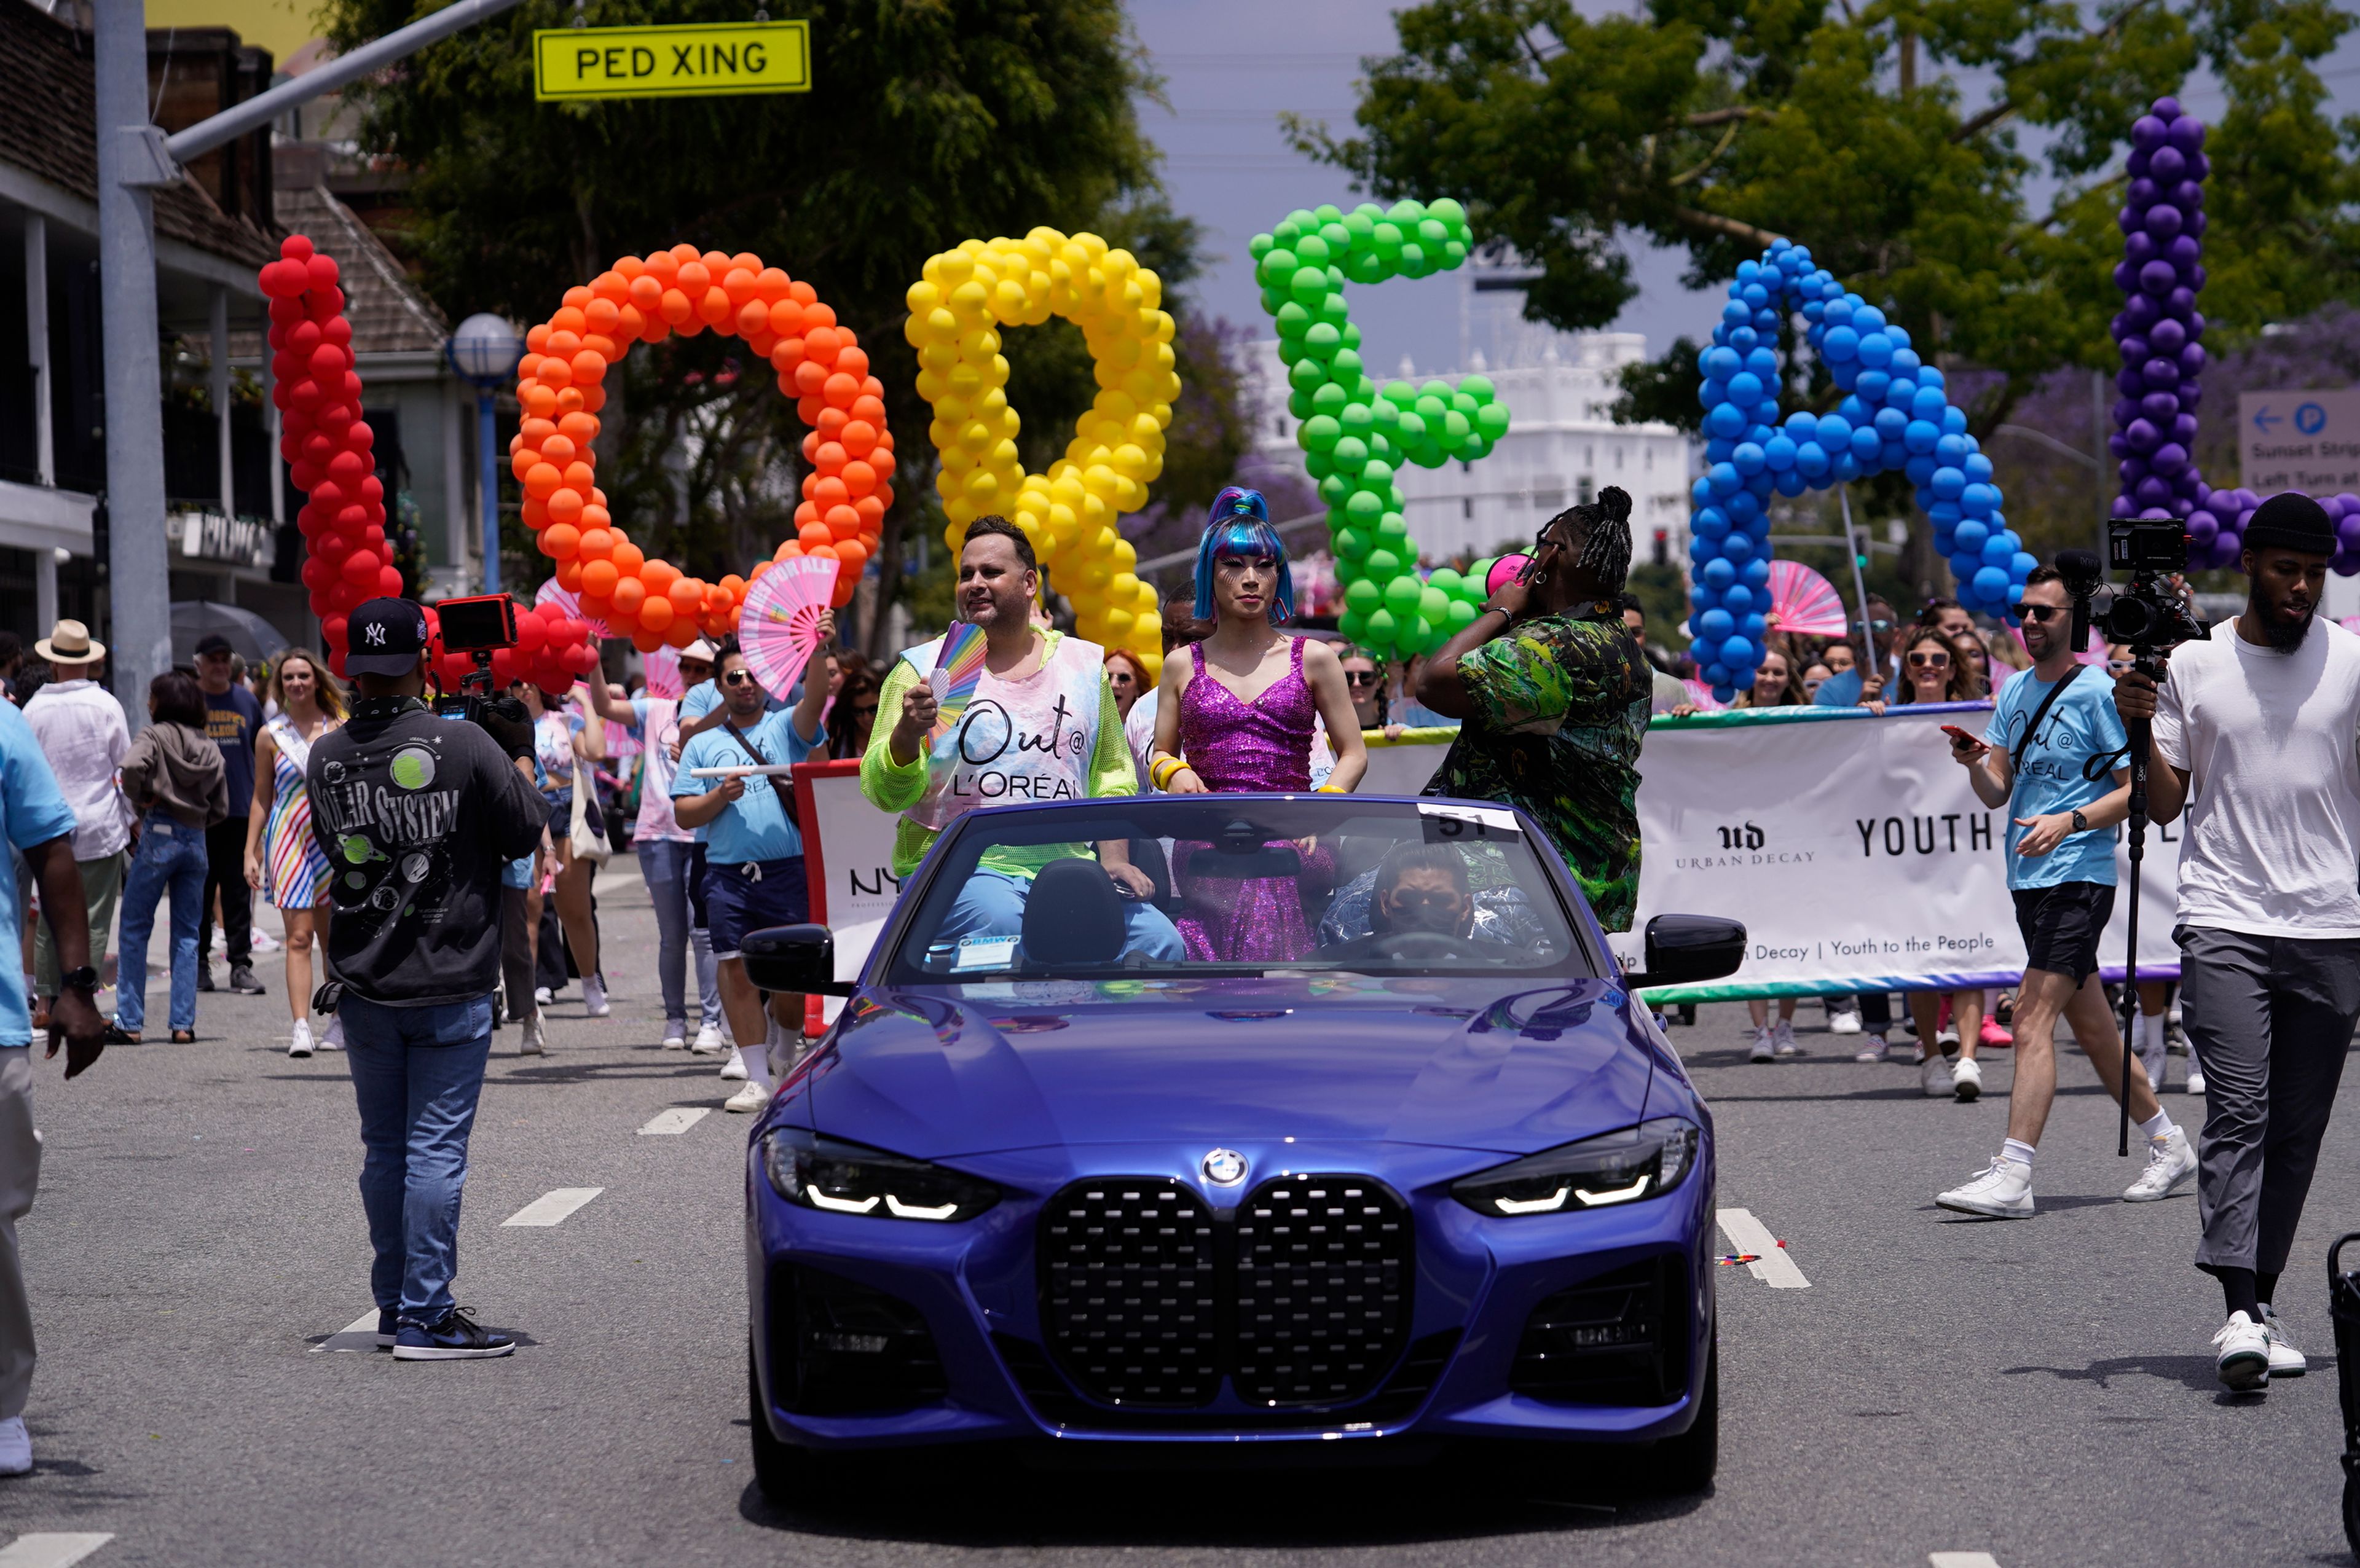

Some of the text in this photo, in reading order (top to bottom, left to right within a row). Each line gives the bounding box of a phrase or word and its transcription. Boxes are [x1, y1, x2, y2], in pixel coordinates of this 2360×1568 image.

[576, 42, 768, 79] PED XING
[2251, 442, 2313, 458] Sunset
[2251, 471, 2289, 487] Left
[2294, 470, 2336, 486] Turn
[766, 560, 800, 588] FOR
[800, 557, 832, 574] ALL
[956, 693, 1085, 766] Out @
[2058, 732, 2074, 749] @
[2019, 759, 2070, 781] RÉAL
[312, 778, 460, 844] SOLAR SYSTEM
[1439, 812, 1486, 836] 51
[1855, 811, 1992, 857] YOUTH
[1676, 851, 1815, 870] URBAN DECAY
[850, 867, 901, 896] NY
[1756, 944, 1809, 962] Decay
[1831, 938, 1878, 956] Youth
[1883, 940, 1900, 953] to
[1906, 935, 1931, 952] the
[1938, 931, 1994, 953] People
